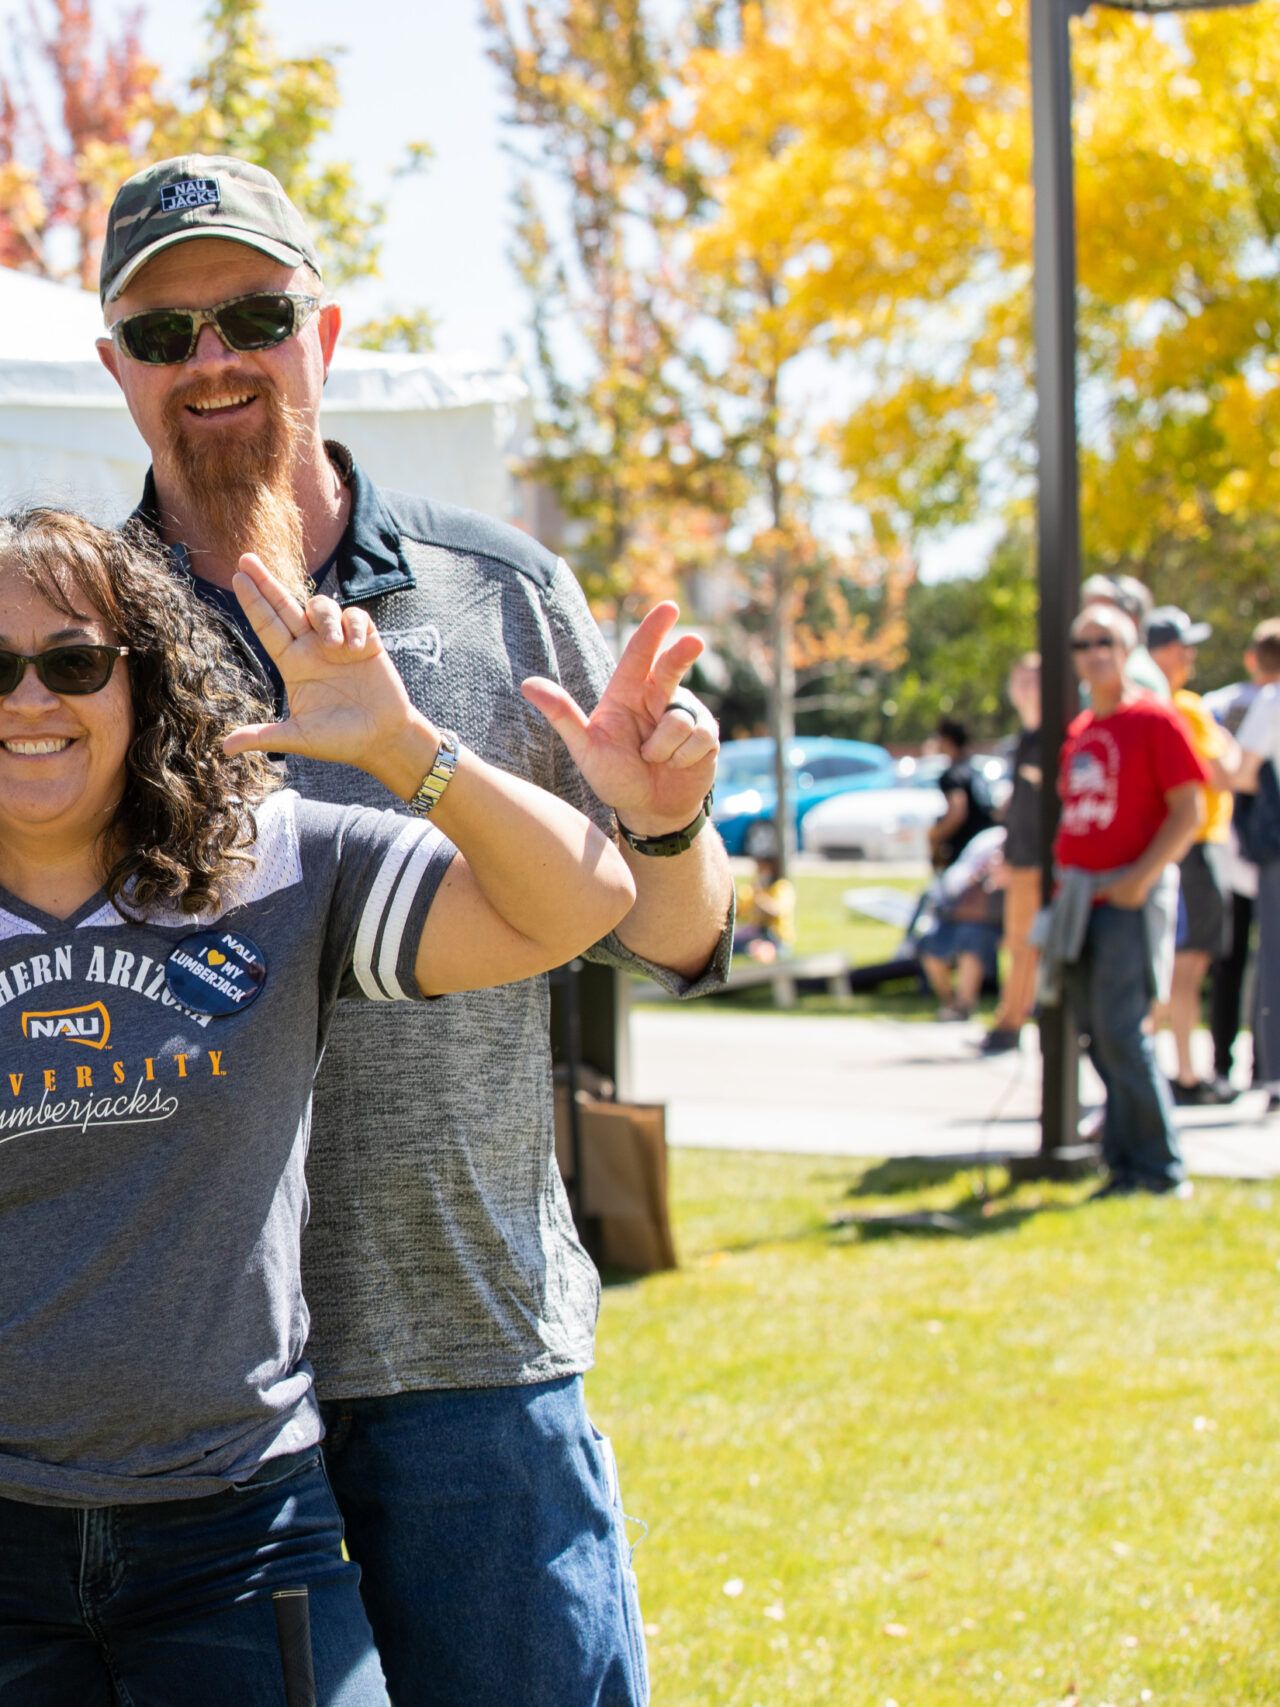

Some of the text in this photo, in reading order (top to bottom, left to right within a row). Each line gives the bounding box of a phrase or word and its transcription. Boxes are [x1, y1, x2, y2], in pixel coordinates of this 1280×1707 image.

[175, 181, 206, 194] NAU
[168, 192, 216, 209] JACKS
[222, 934, 256, 963] NAU
[198, 947, 244, 979] I MY
[169, 949, 246, 1003] LUMBERJACK
[30, 1017, 99, 1039] NAU
